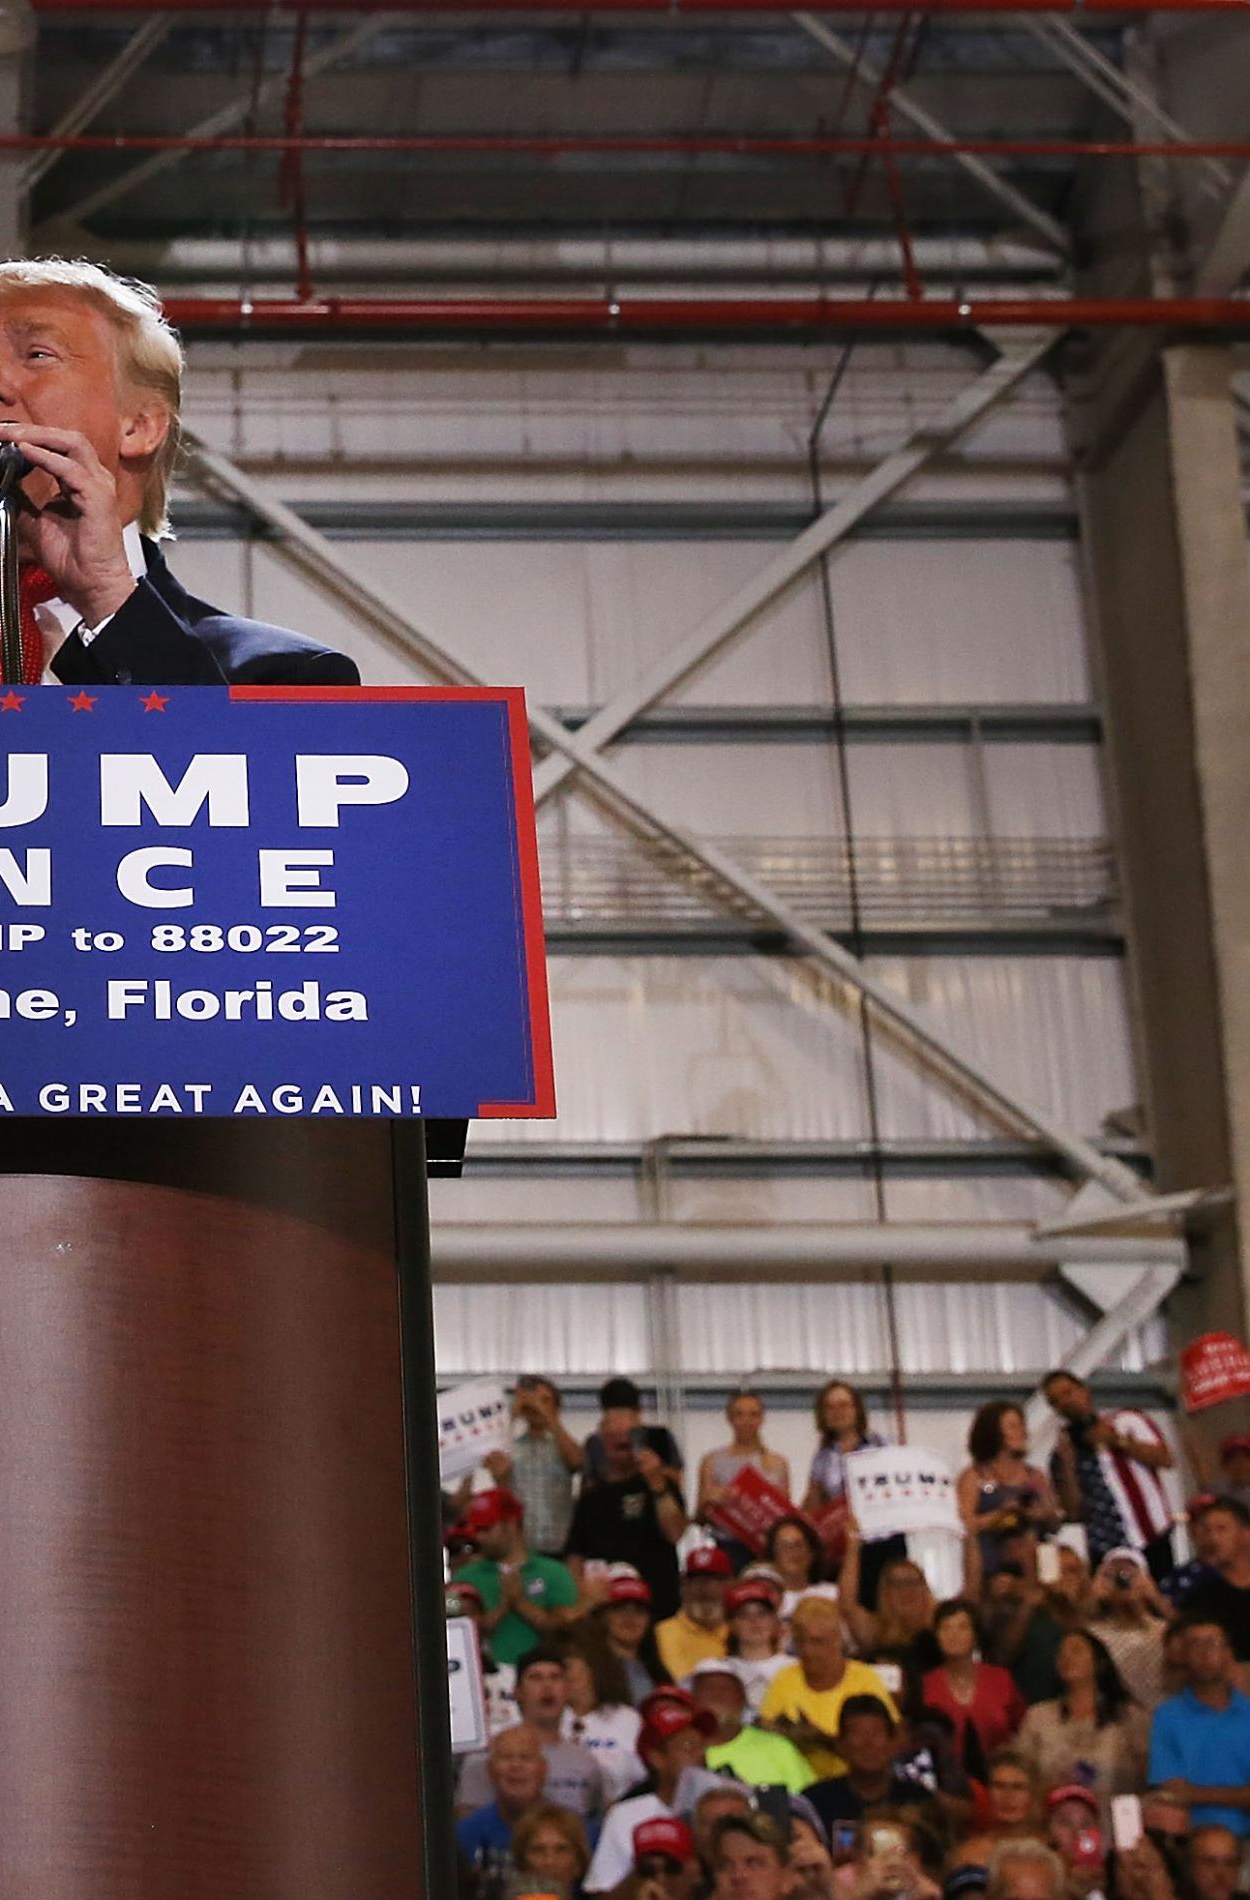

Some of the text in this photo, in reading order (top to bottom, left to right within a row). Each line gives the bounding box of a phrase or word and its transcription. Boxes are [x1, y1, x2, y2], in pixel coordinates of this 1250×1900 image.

[72, 927, 125, 952] to
[151, 924, 340, 953] 88022
[107, 980, 369, 1021] Florida
[39, 1083, 213, 1114] GREAT
[233, 1084, 421, 1115] AGAIN!
